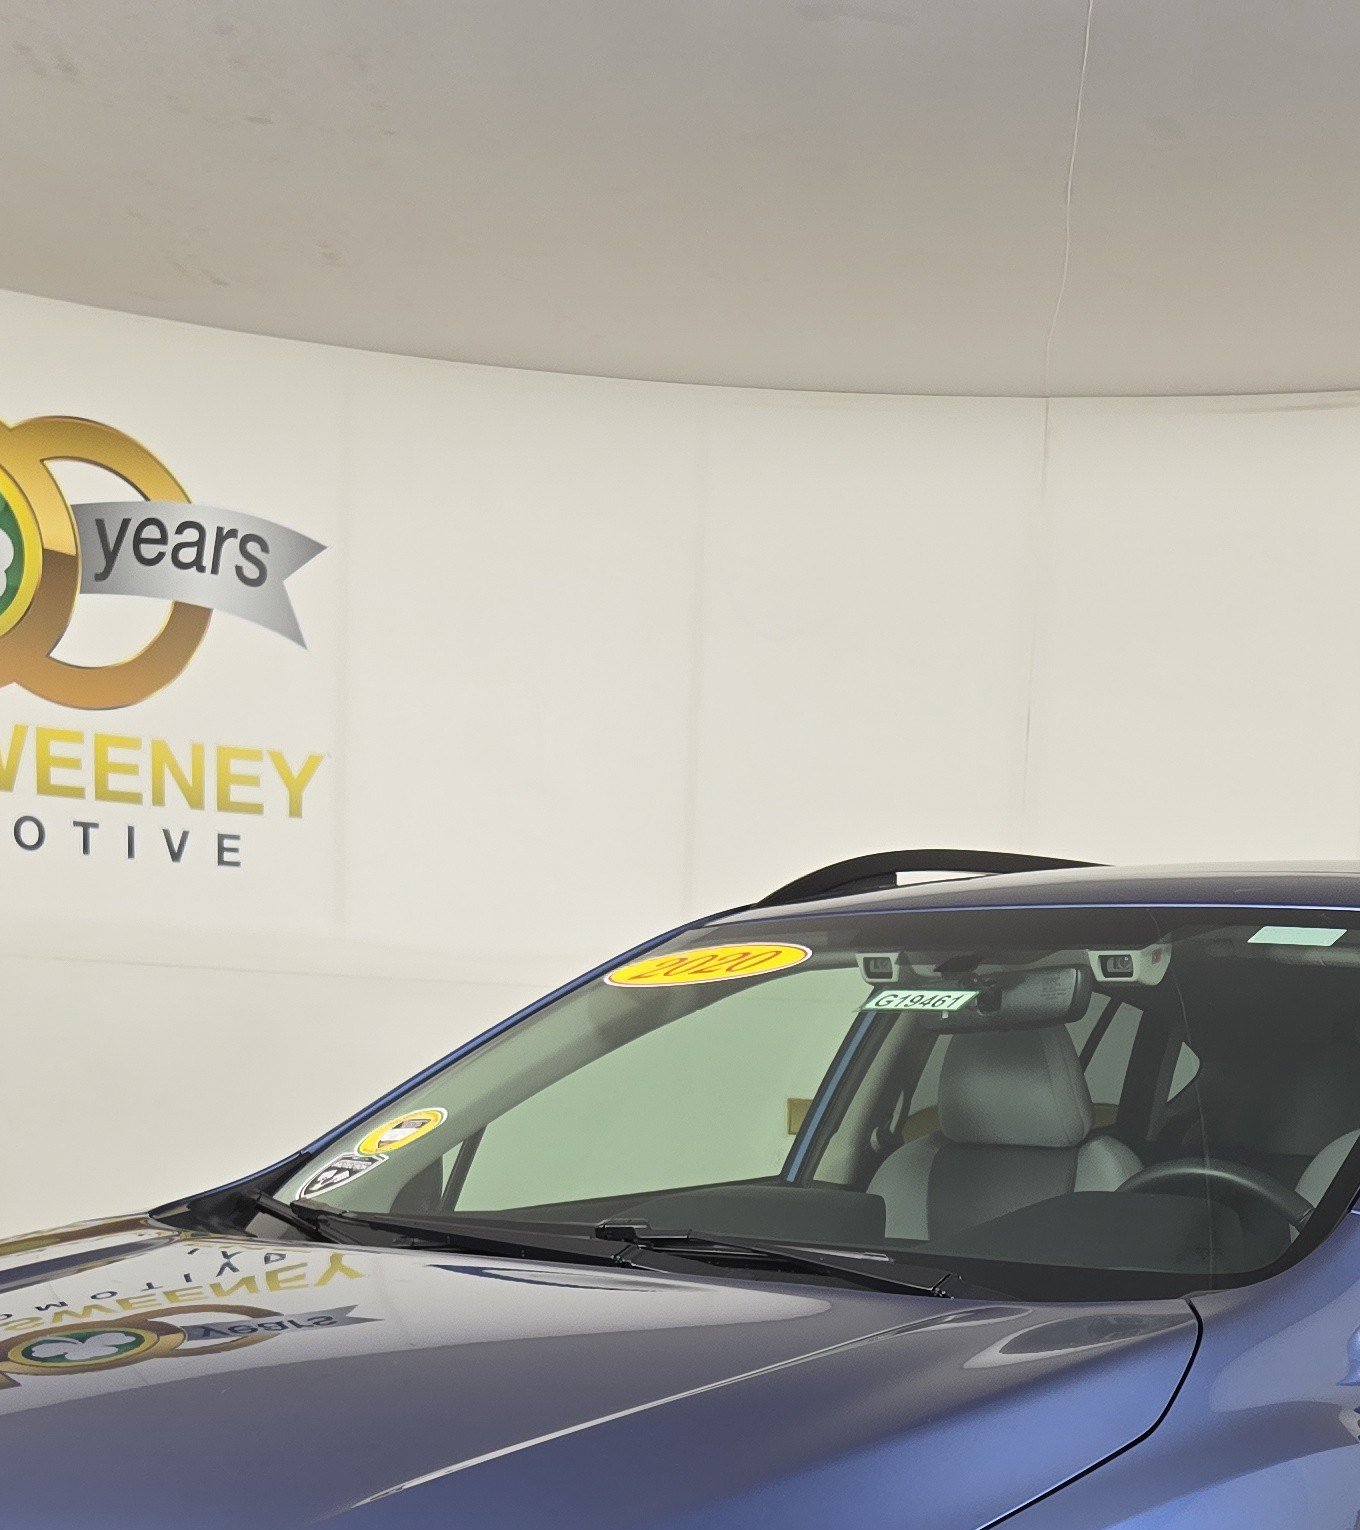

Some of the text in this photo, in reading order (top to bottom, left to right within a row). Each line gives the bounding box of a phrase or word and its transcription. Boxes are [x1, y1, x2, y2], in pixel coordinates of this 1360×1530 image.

[93, 515, 270, 588] years
[627, 950, 782, 981] 2020
[875, 993, 965, 1008] G19461
